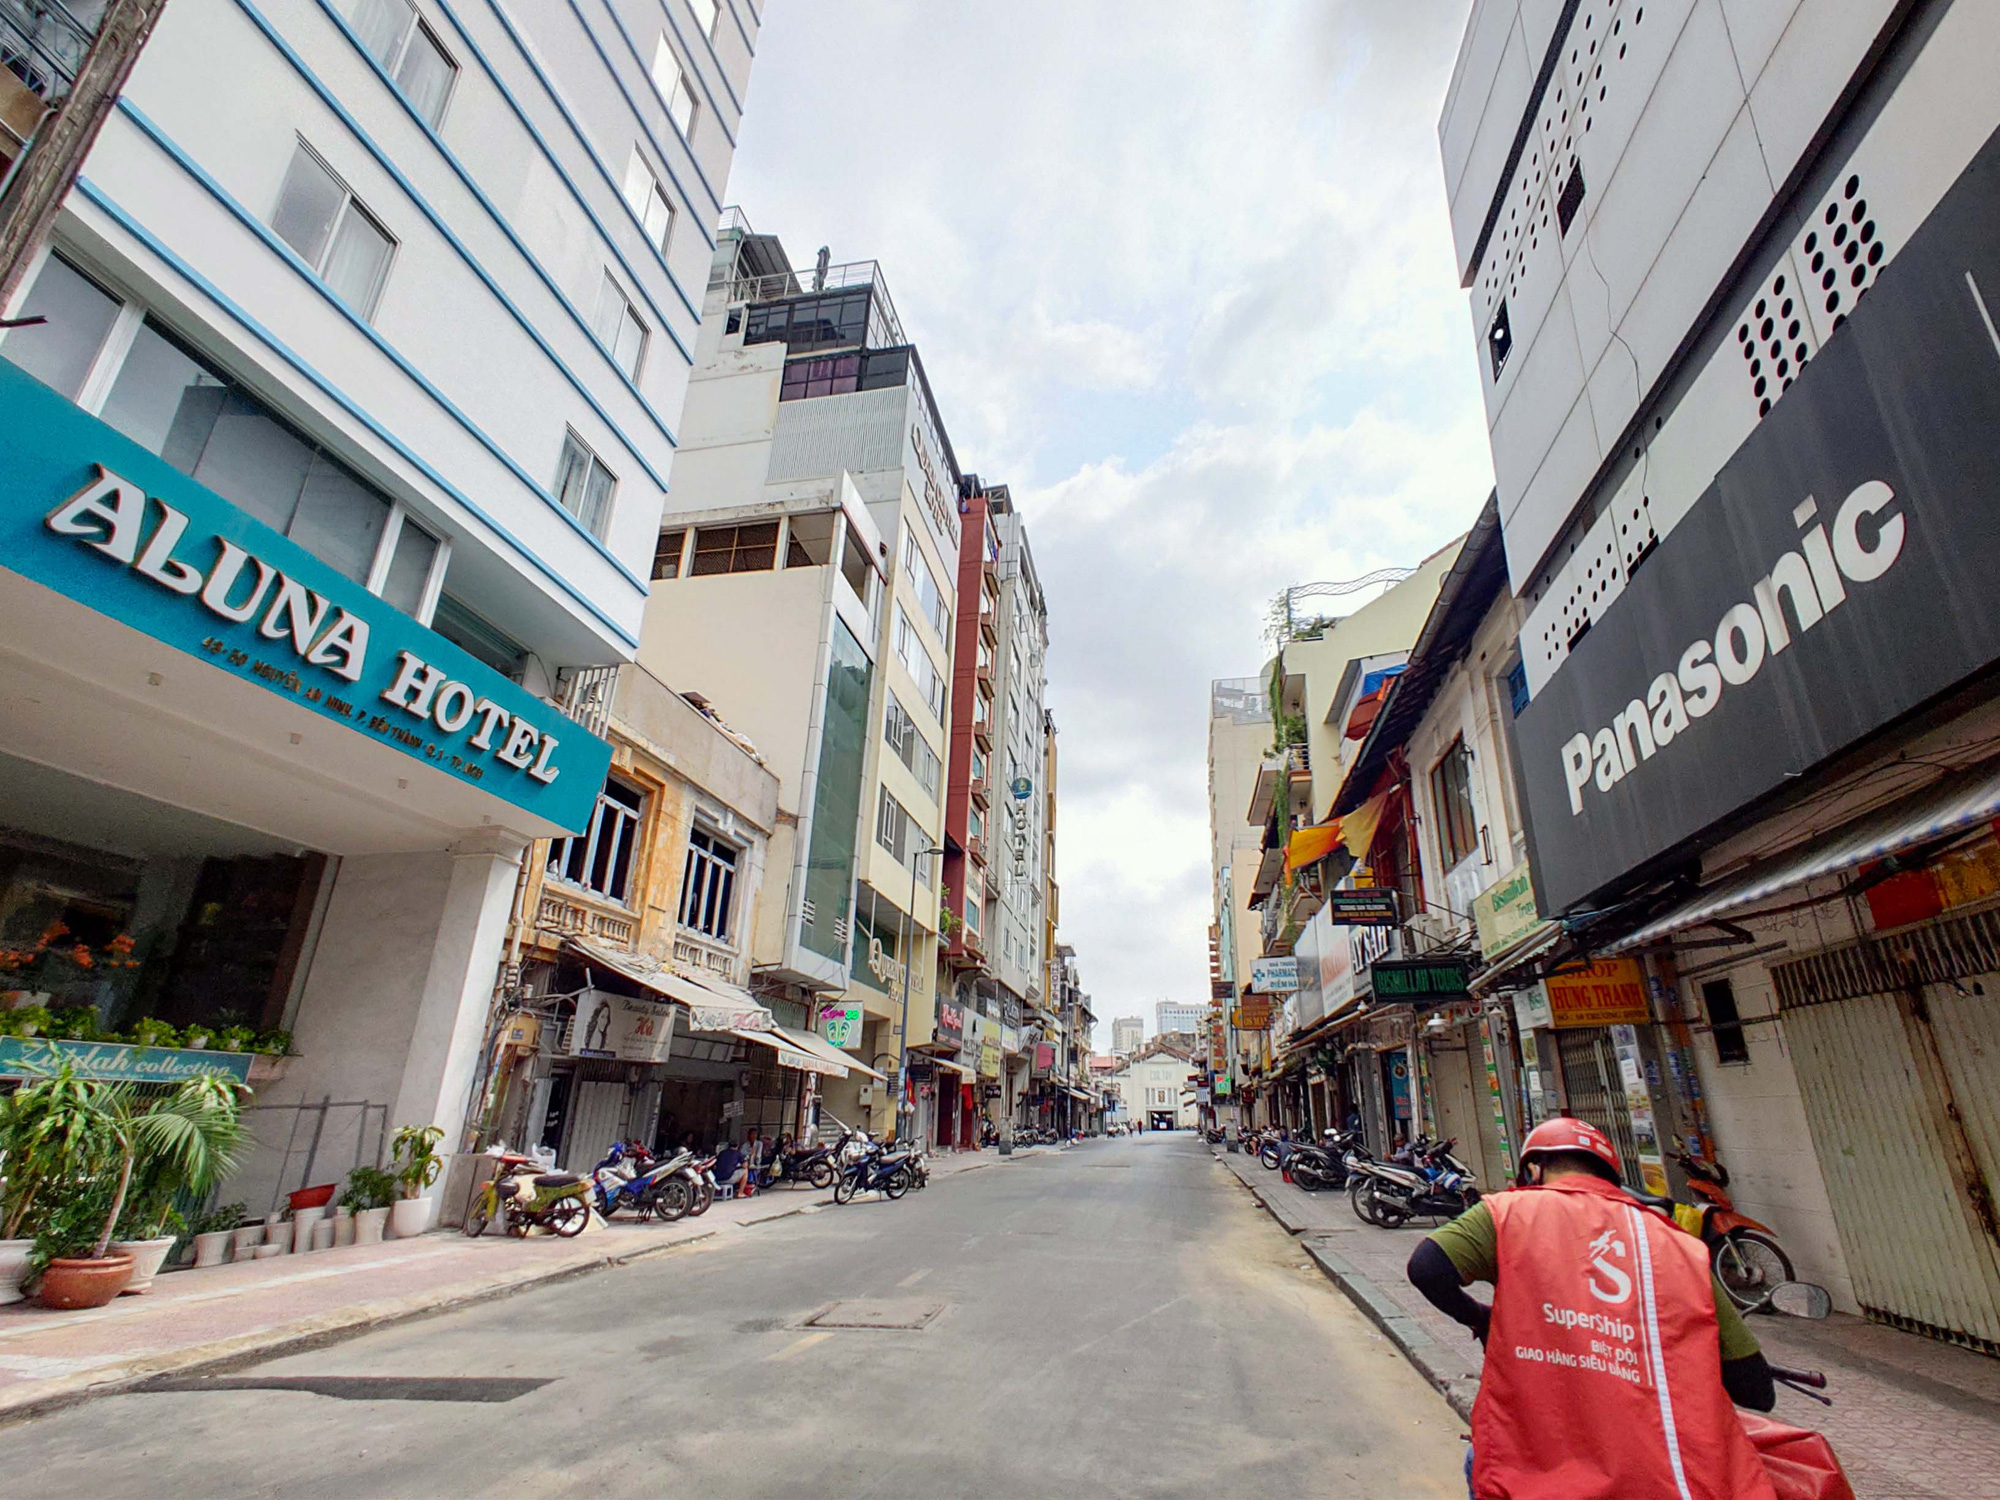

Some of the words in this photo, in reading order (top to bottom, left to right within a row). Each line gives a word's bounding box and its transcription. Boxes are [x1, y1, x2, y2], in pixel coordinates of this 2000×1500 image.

[45, 463, 370, 681] ALUNA
[380, 650, 561, 784] HOTEL
[1561, 480, 1906, 816] Panasonic
[1015, 802, 1028, 876] HOTEL
[1376, 969, 1429, 994] BISMILLAH
[1431, 966, 1464, 992] TOURS
[1552, 980, 1593, 1010] HÙNG
[1591, 983, 1643, 1008] THANH
[134, 1055, 232, 1075] collection
[1543, 1303, 1635, 1344] SuperShip
[1515, 1346, 1544, 1362] GIAO
[1546, 1348, 1577, 1368] HÀNG
[1579, 1354, 1606, 1372] SIÊU
